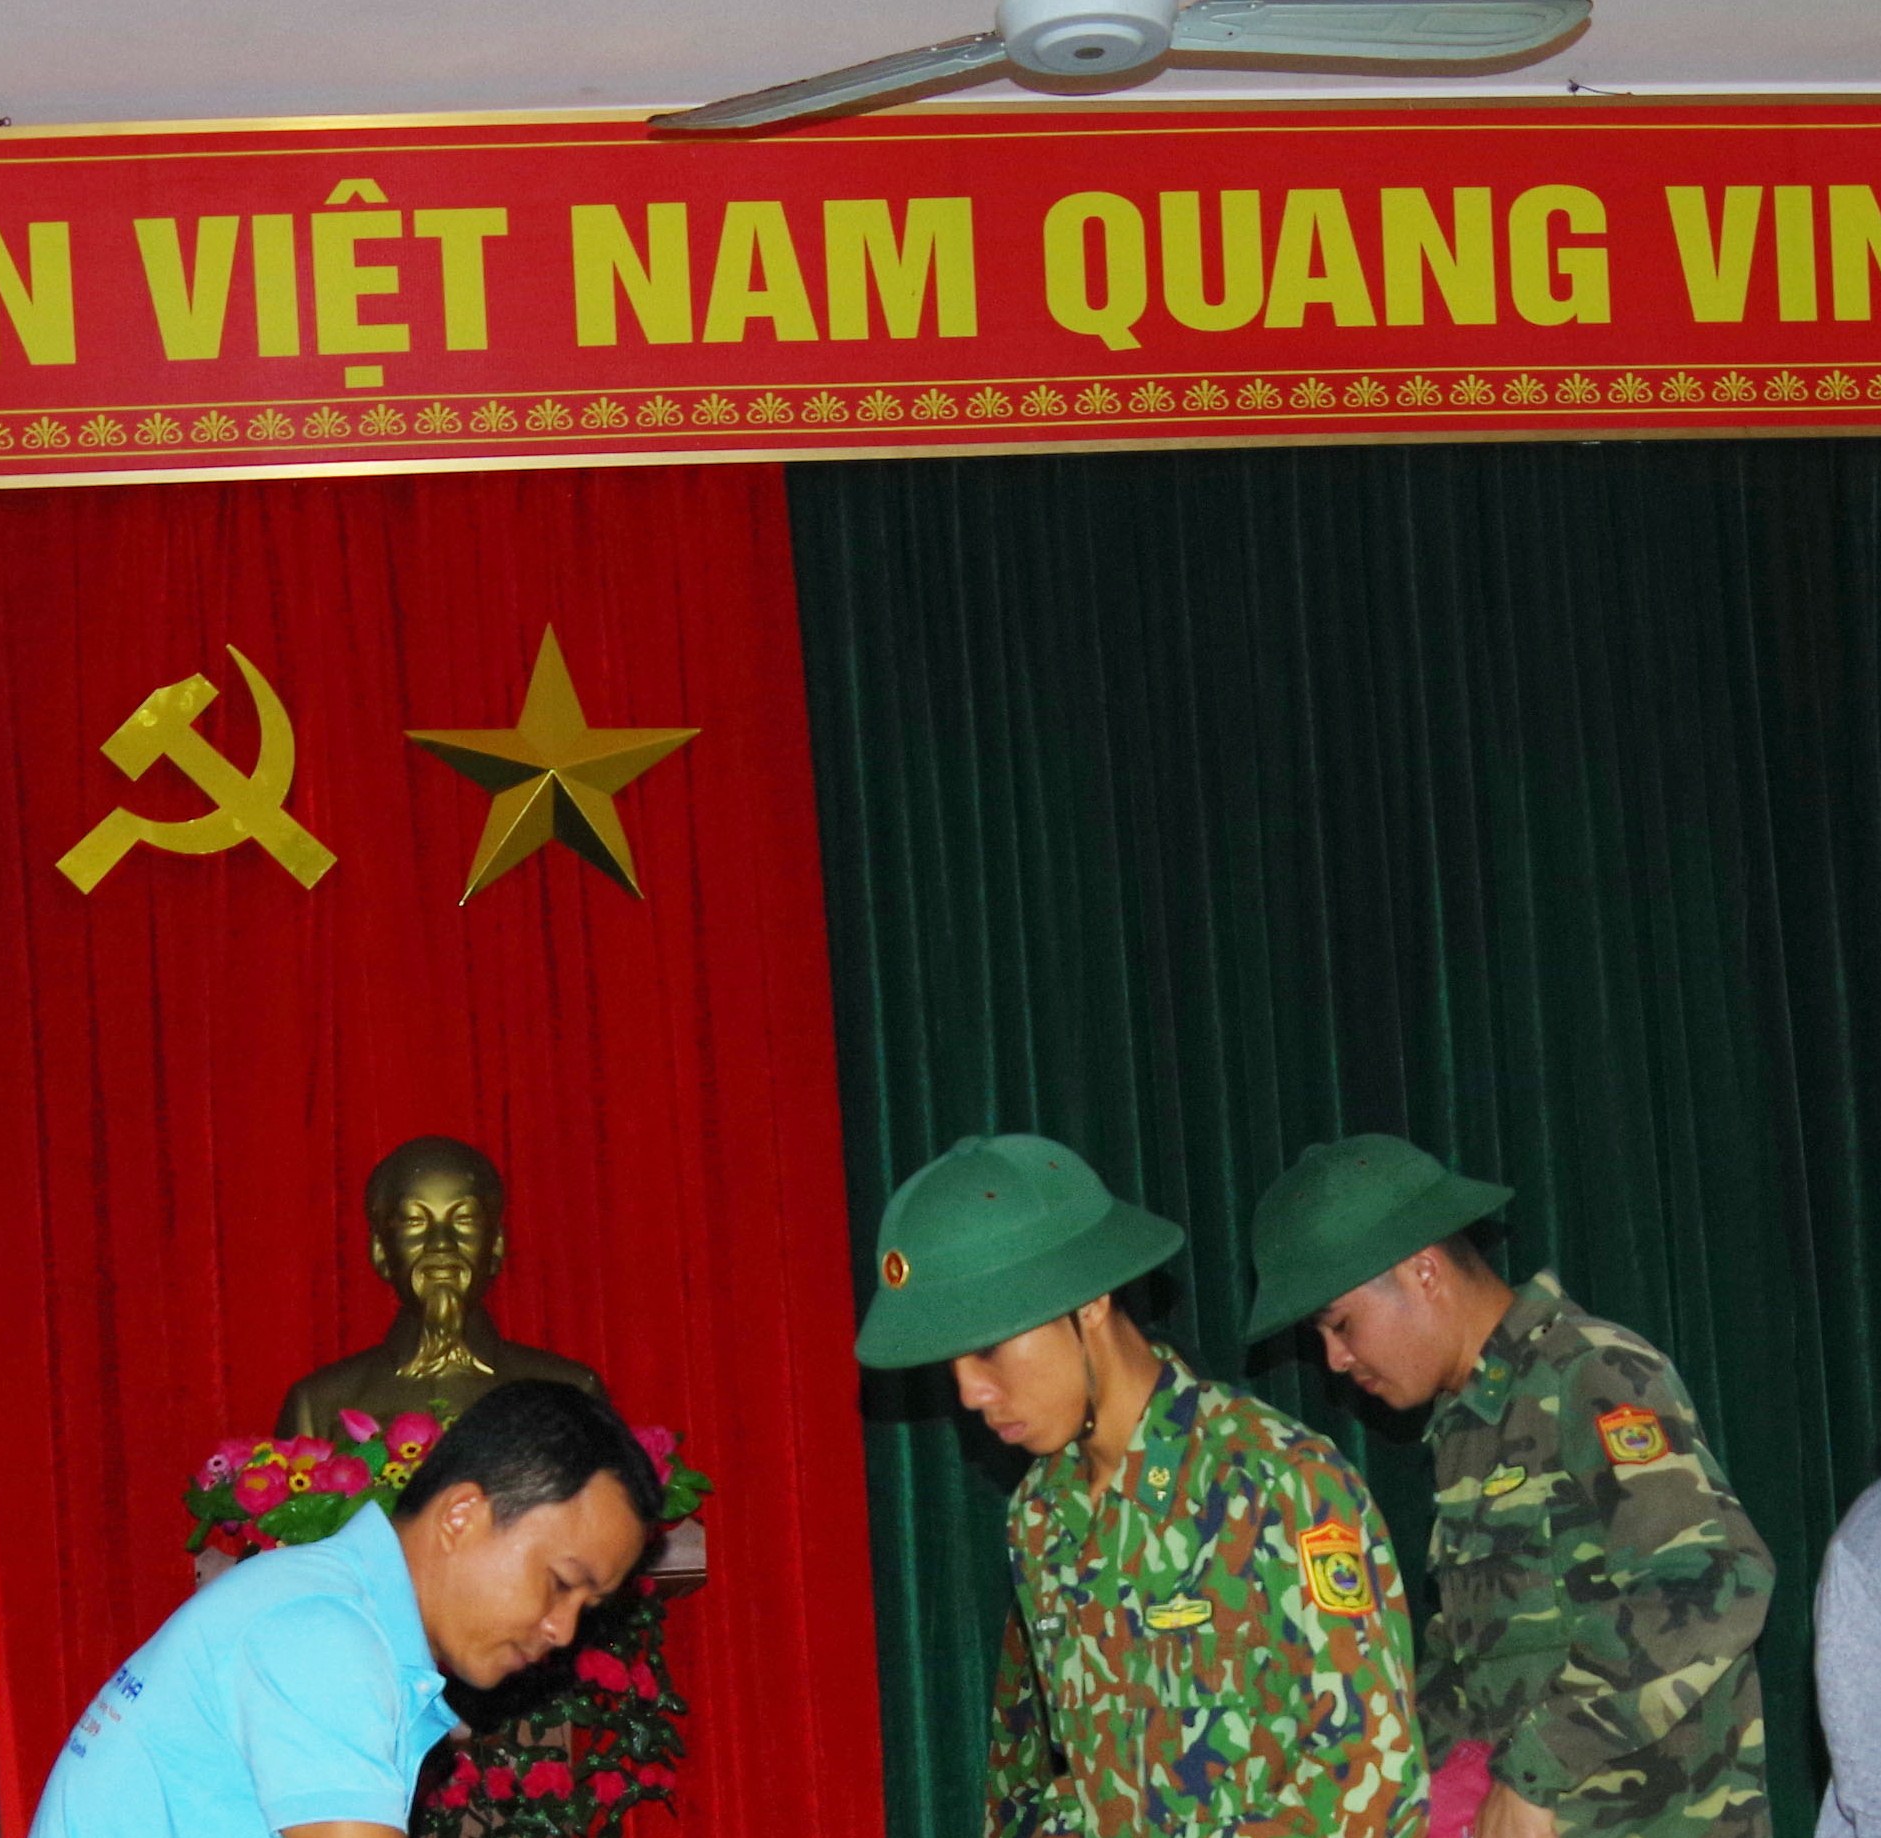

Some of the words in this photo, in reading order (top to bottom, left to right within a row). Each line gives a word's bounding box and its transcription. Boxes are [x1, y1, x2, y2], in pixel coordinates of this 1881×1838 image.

[132, 178, 509, 389] VIỆT
[571, 197, 978, 347] NAM
[1043, 184, 1611, 351] QUANG
